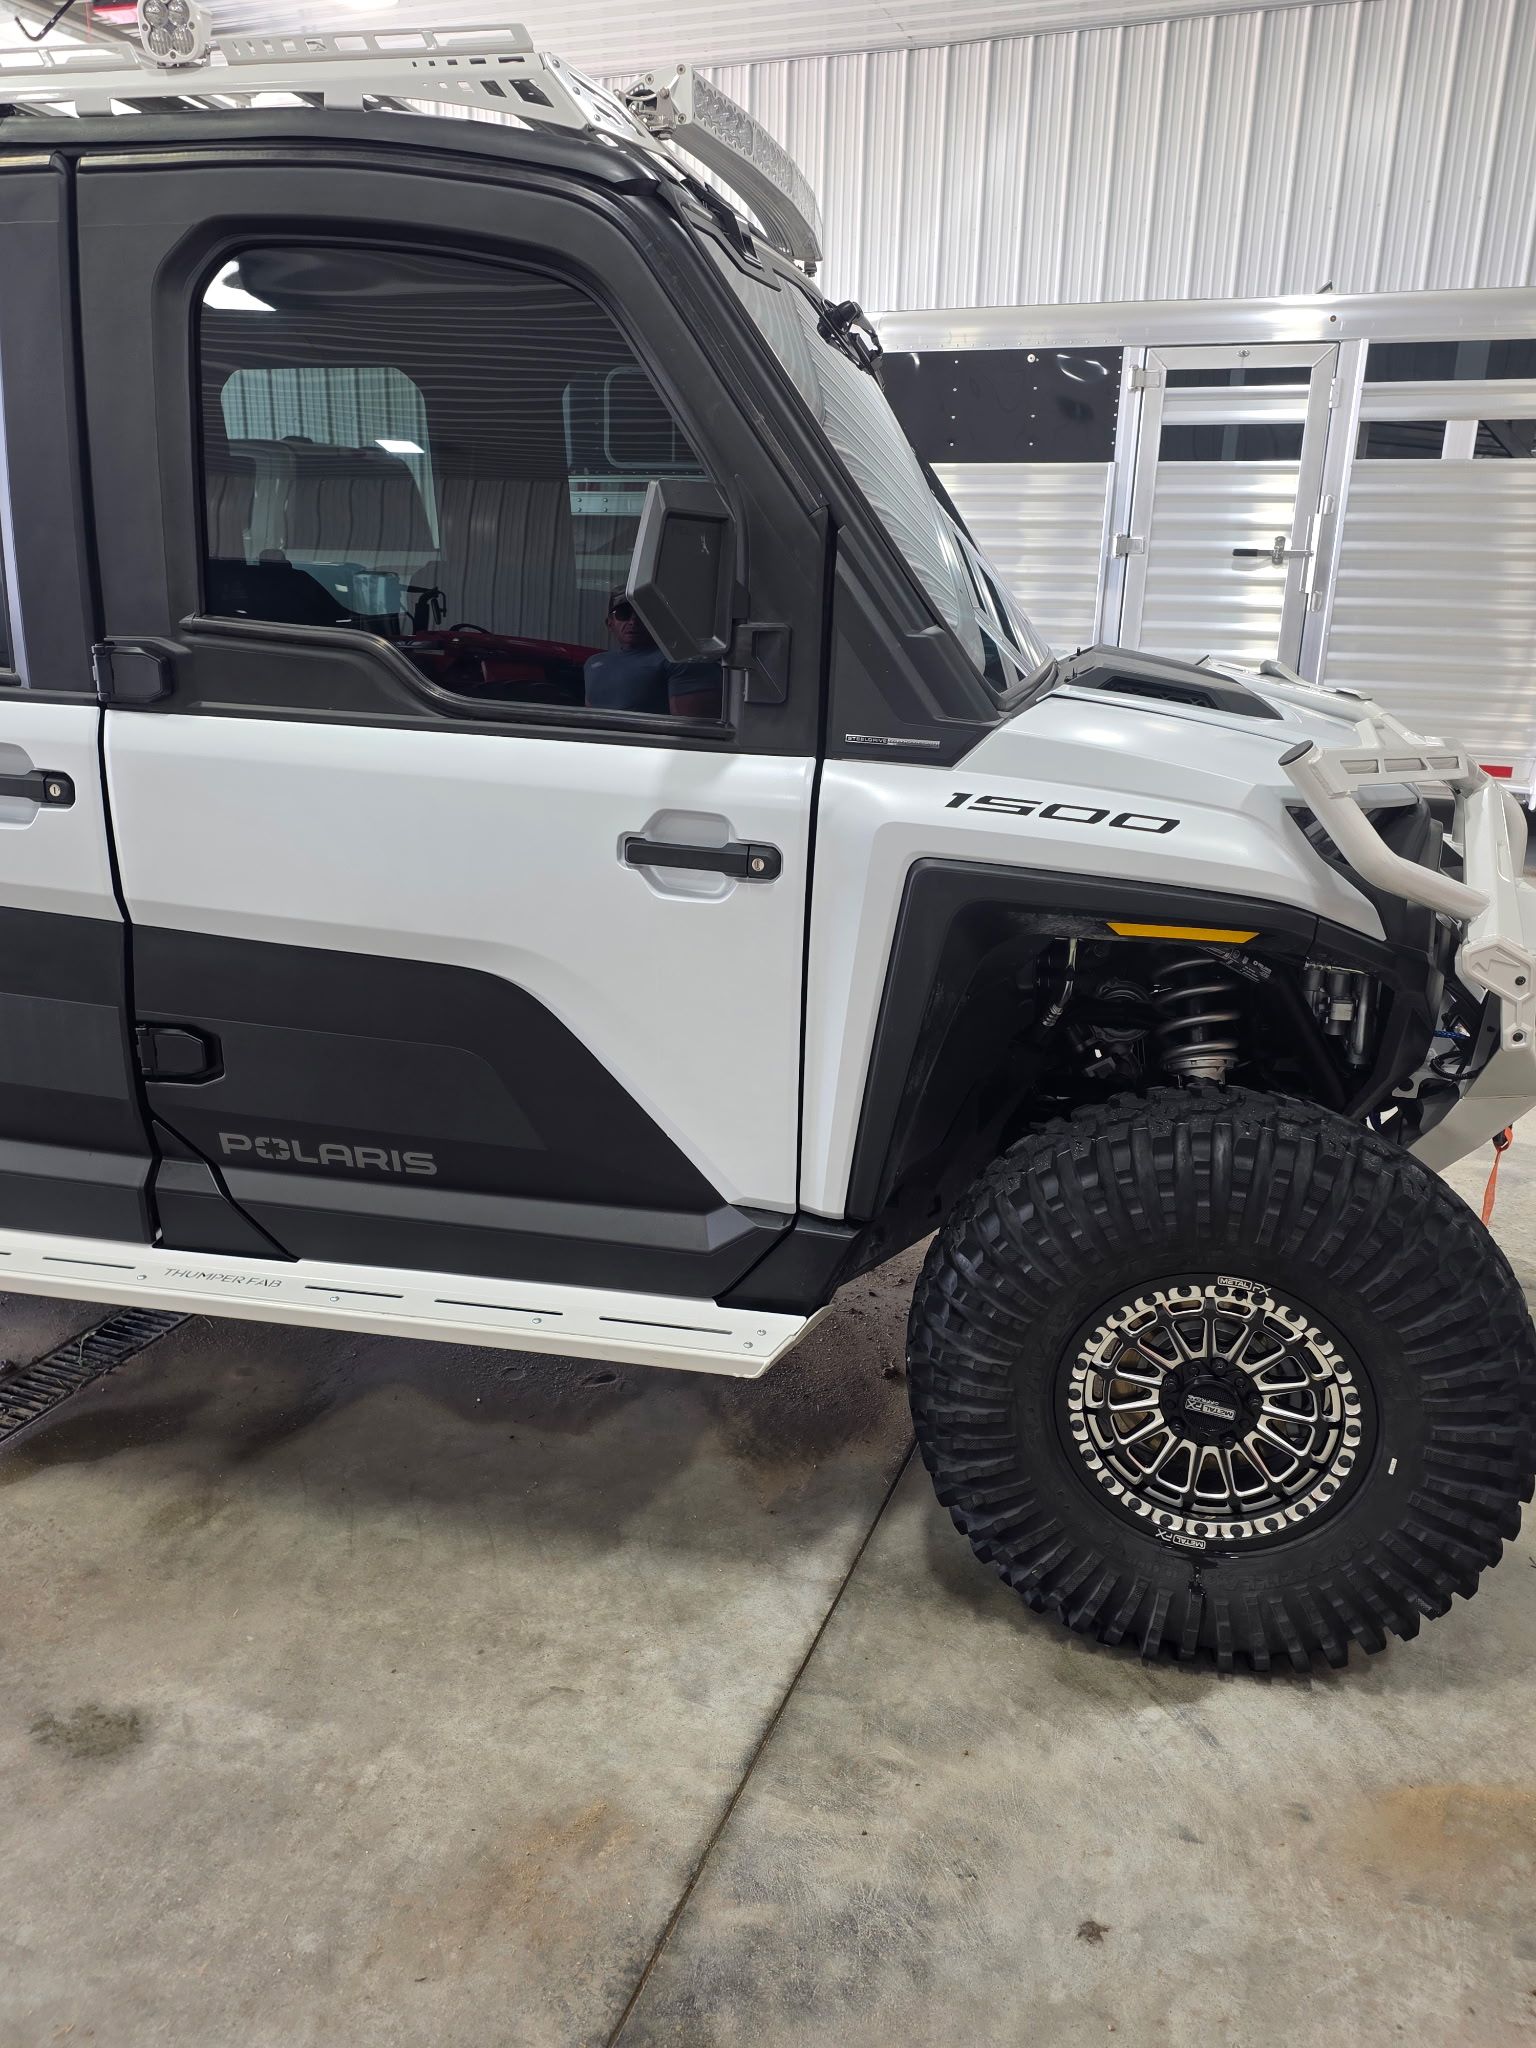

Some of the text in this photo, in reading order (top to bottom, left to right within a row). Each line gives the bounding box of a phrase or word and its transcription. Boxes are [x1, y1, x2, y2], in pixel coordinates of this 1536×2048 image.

[944, 792, 1181, 834] 1500
[217, 1132, 438, 1176] POLARIS
[164, 1267, 282, 1288] THUMPER FAB
[1219, 1277, 1271, 1296] METAL FX
[1203, 1404, 1235, 1419] METAL
[1155, 1528, 1205, 1548] METAL FX
